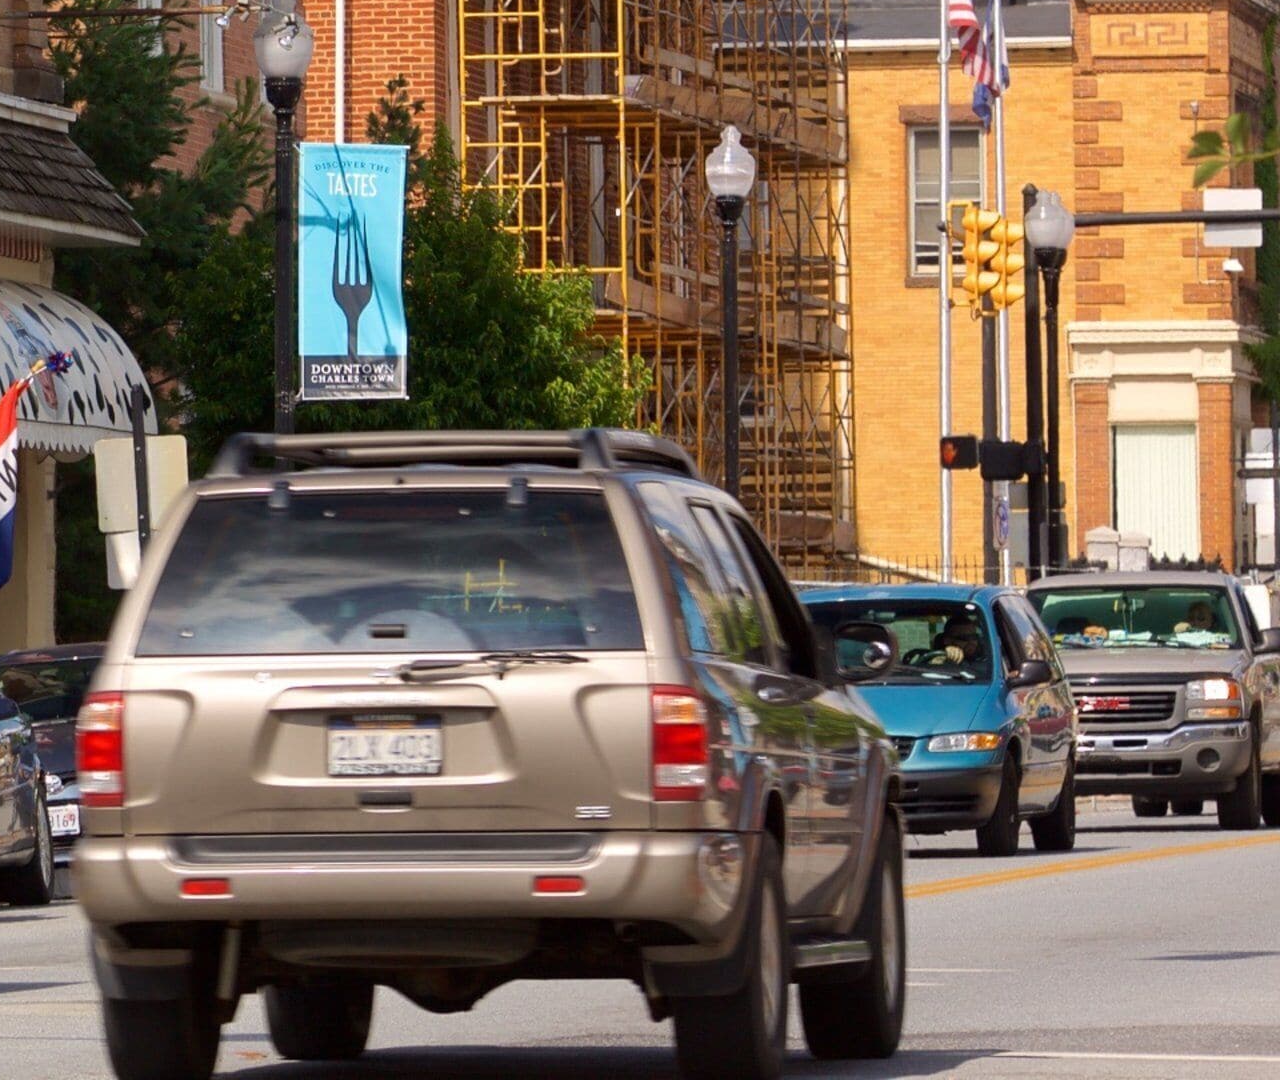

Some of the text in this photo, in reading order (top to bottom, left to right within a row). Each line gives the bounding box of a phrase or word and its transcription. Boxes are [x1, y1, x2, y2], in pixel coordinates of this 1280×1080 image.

[314, 161, 391, 174] DISCOVER THE
[327, 172, 377, 197] TASTES
[311, 363, 394, 375] DOWNTOWN
[311, 374, 394, 384] CHARLES TOWN
